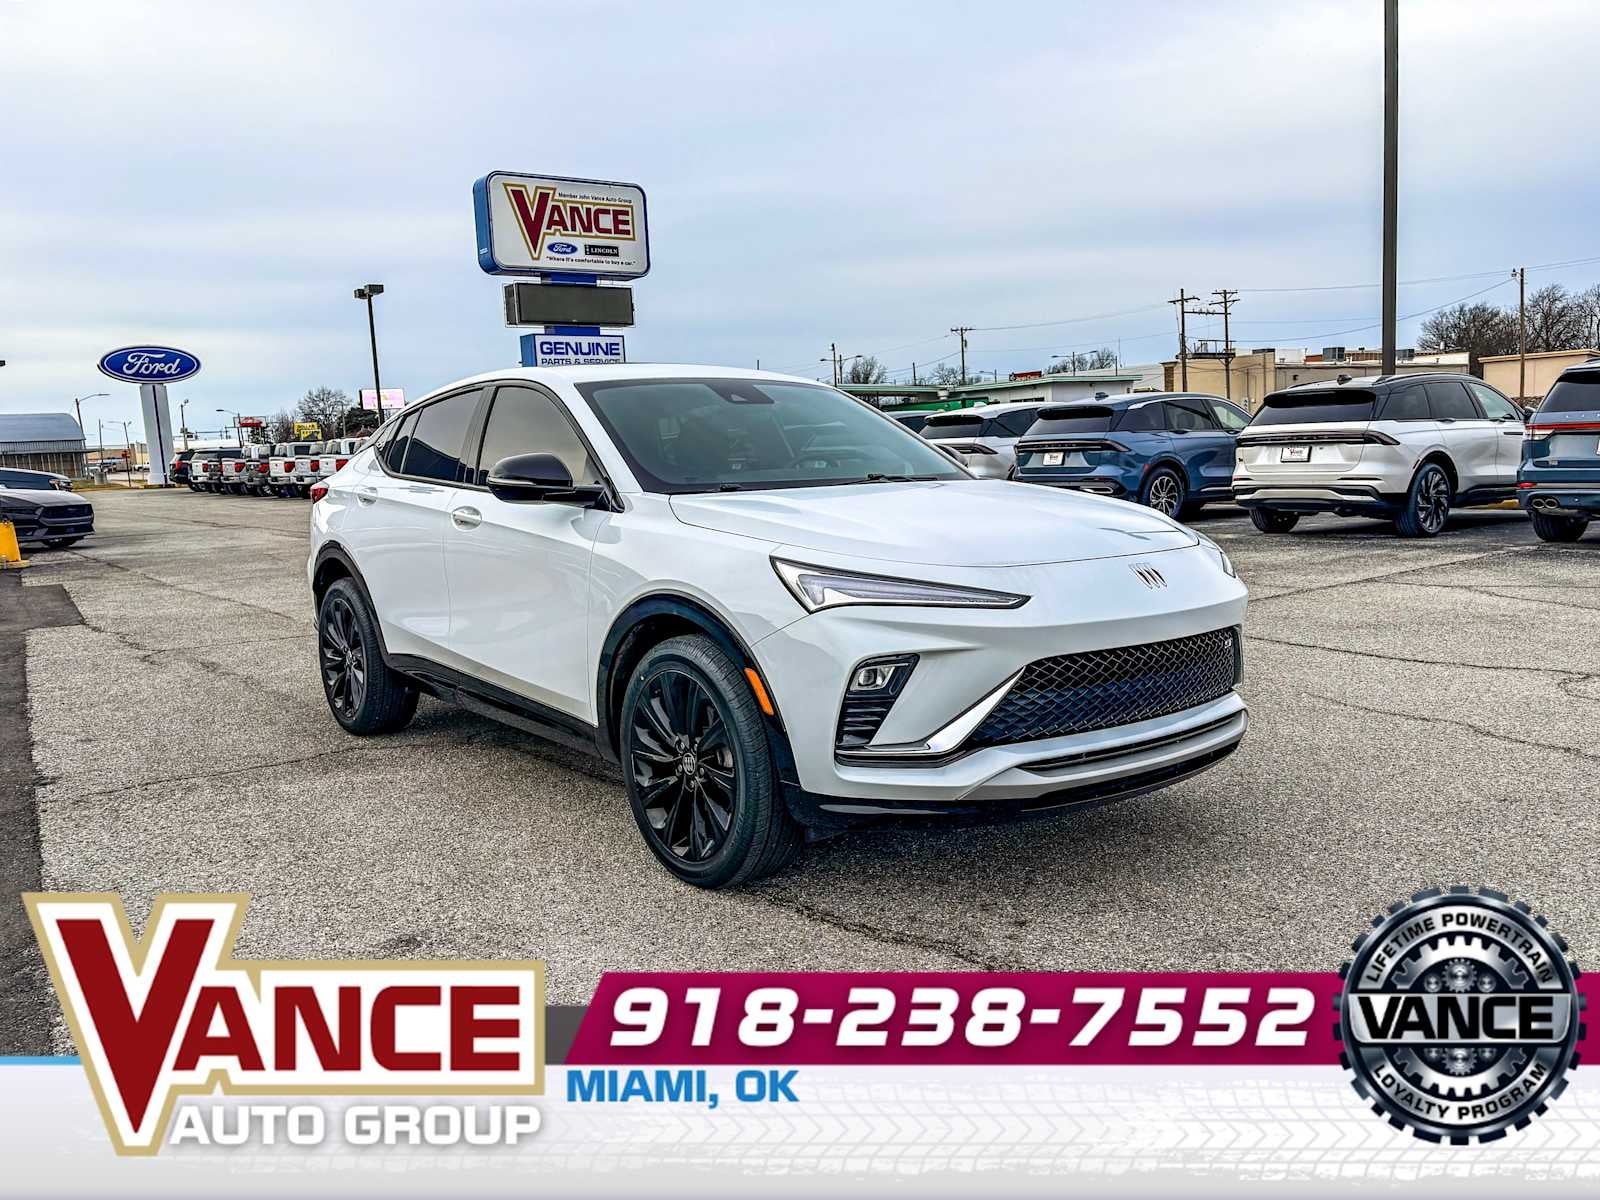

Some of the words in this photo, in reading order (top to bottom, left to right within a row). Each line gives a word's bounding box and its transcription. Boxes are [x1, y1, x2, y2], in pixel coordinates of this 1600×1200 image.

[509, 188, 631, 255] VANCE
[552, 243, 573, 253] Ford
[590, 247, 618, 255] LINCOLN
[539, 341, 621, 356] GENUINE
[122, 352, 181, 375] Ford
